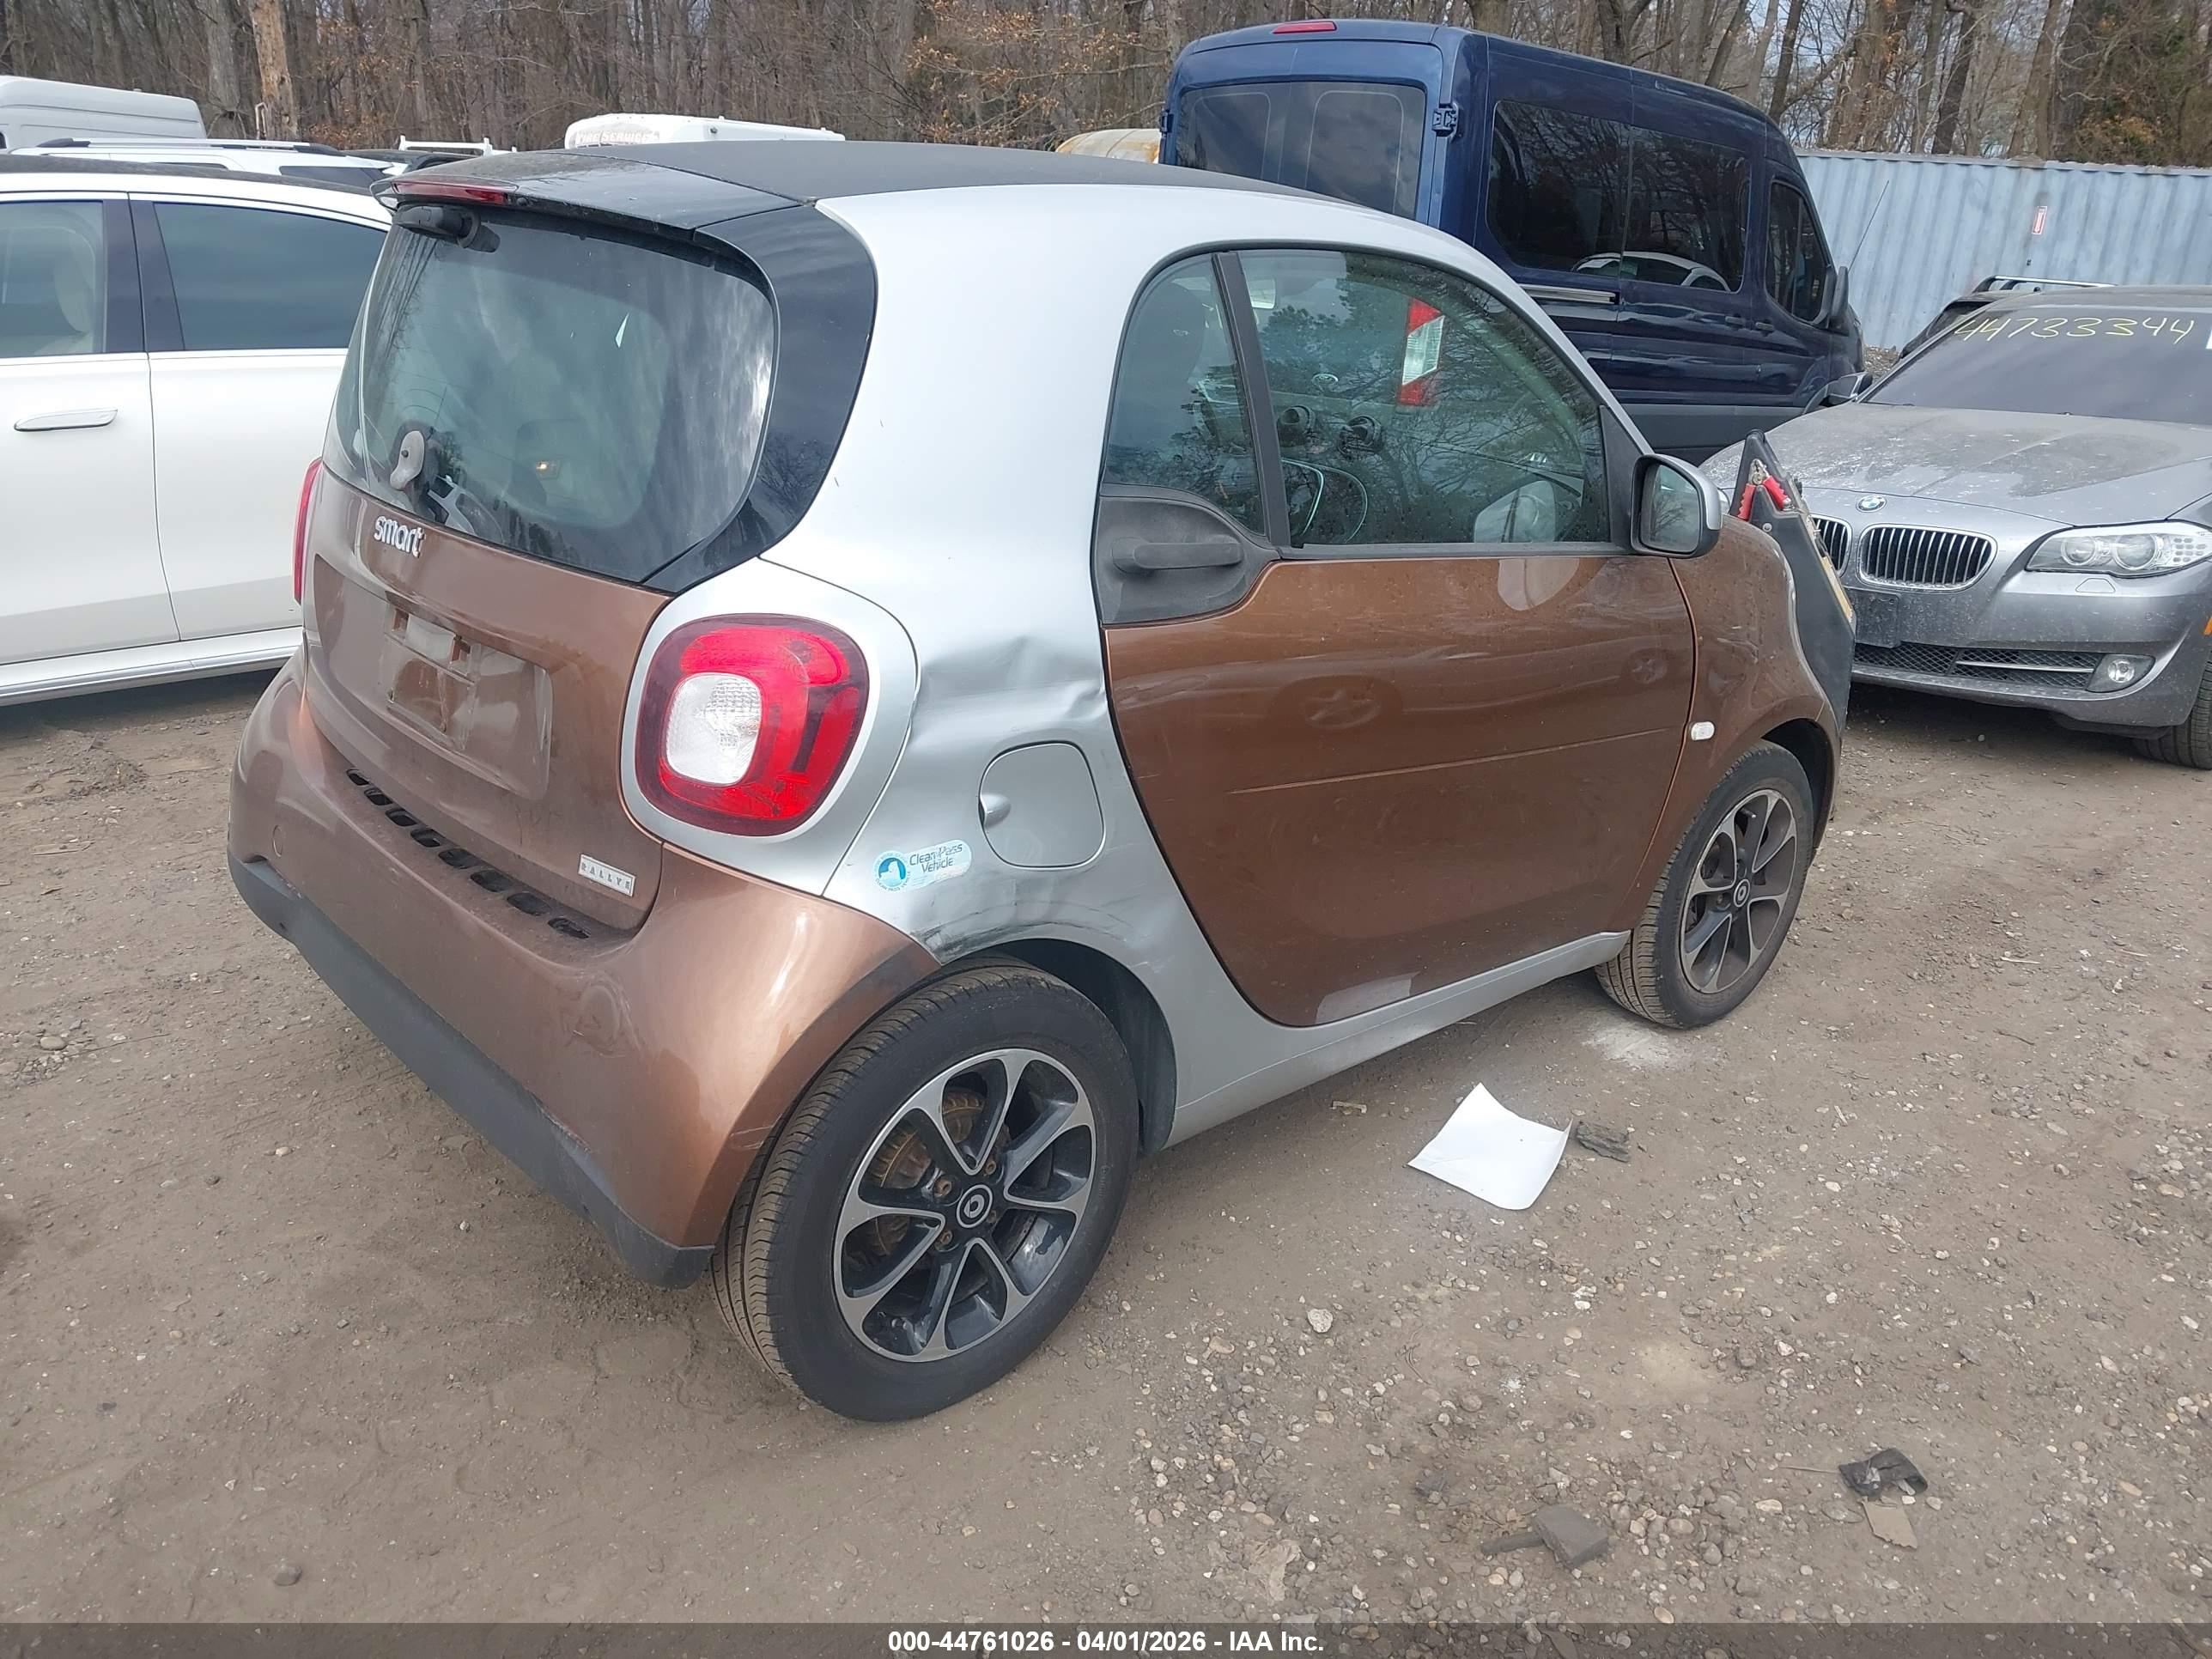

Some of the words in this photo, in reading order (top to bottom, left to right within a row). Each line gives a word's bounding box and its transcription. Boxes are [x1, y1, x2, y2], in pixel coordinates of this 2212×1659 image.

[1954, 317, 2195, 344] 44733344
[374, 515, 426, 558] smart
[909, 852, 937, 866] Clean
[938, 844, 963, 858] Pass
[921, 857, 954, 872] Vehicle
